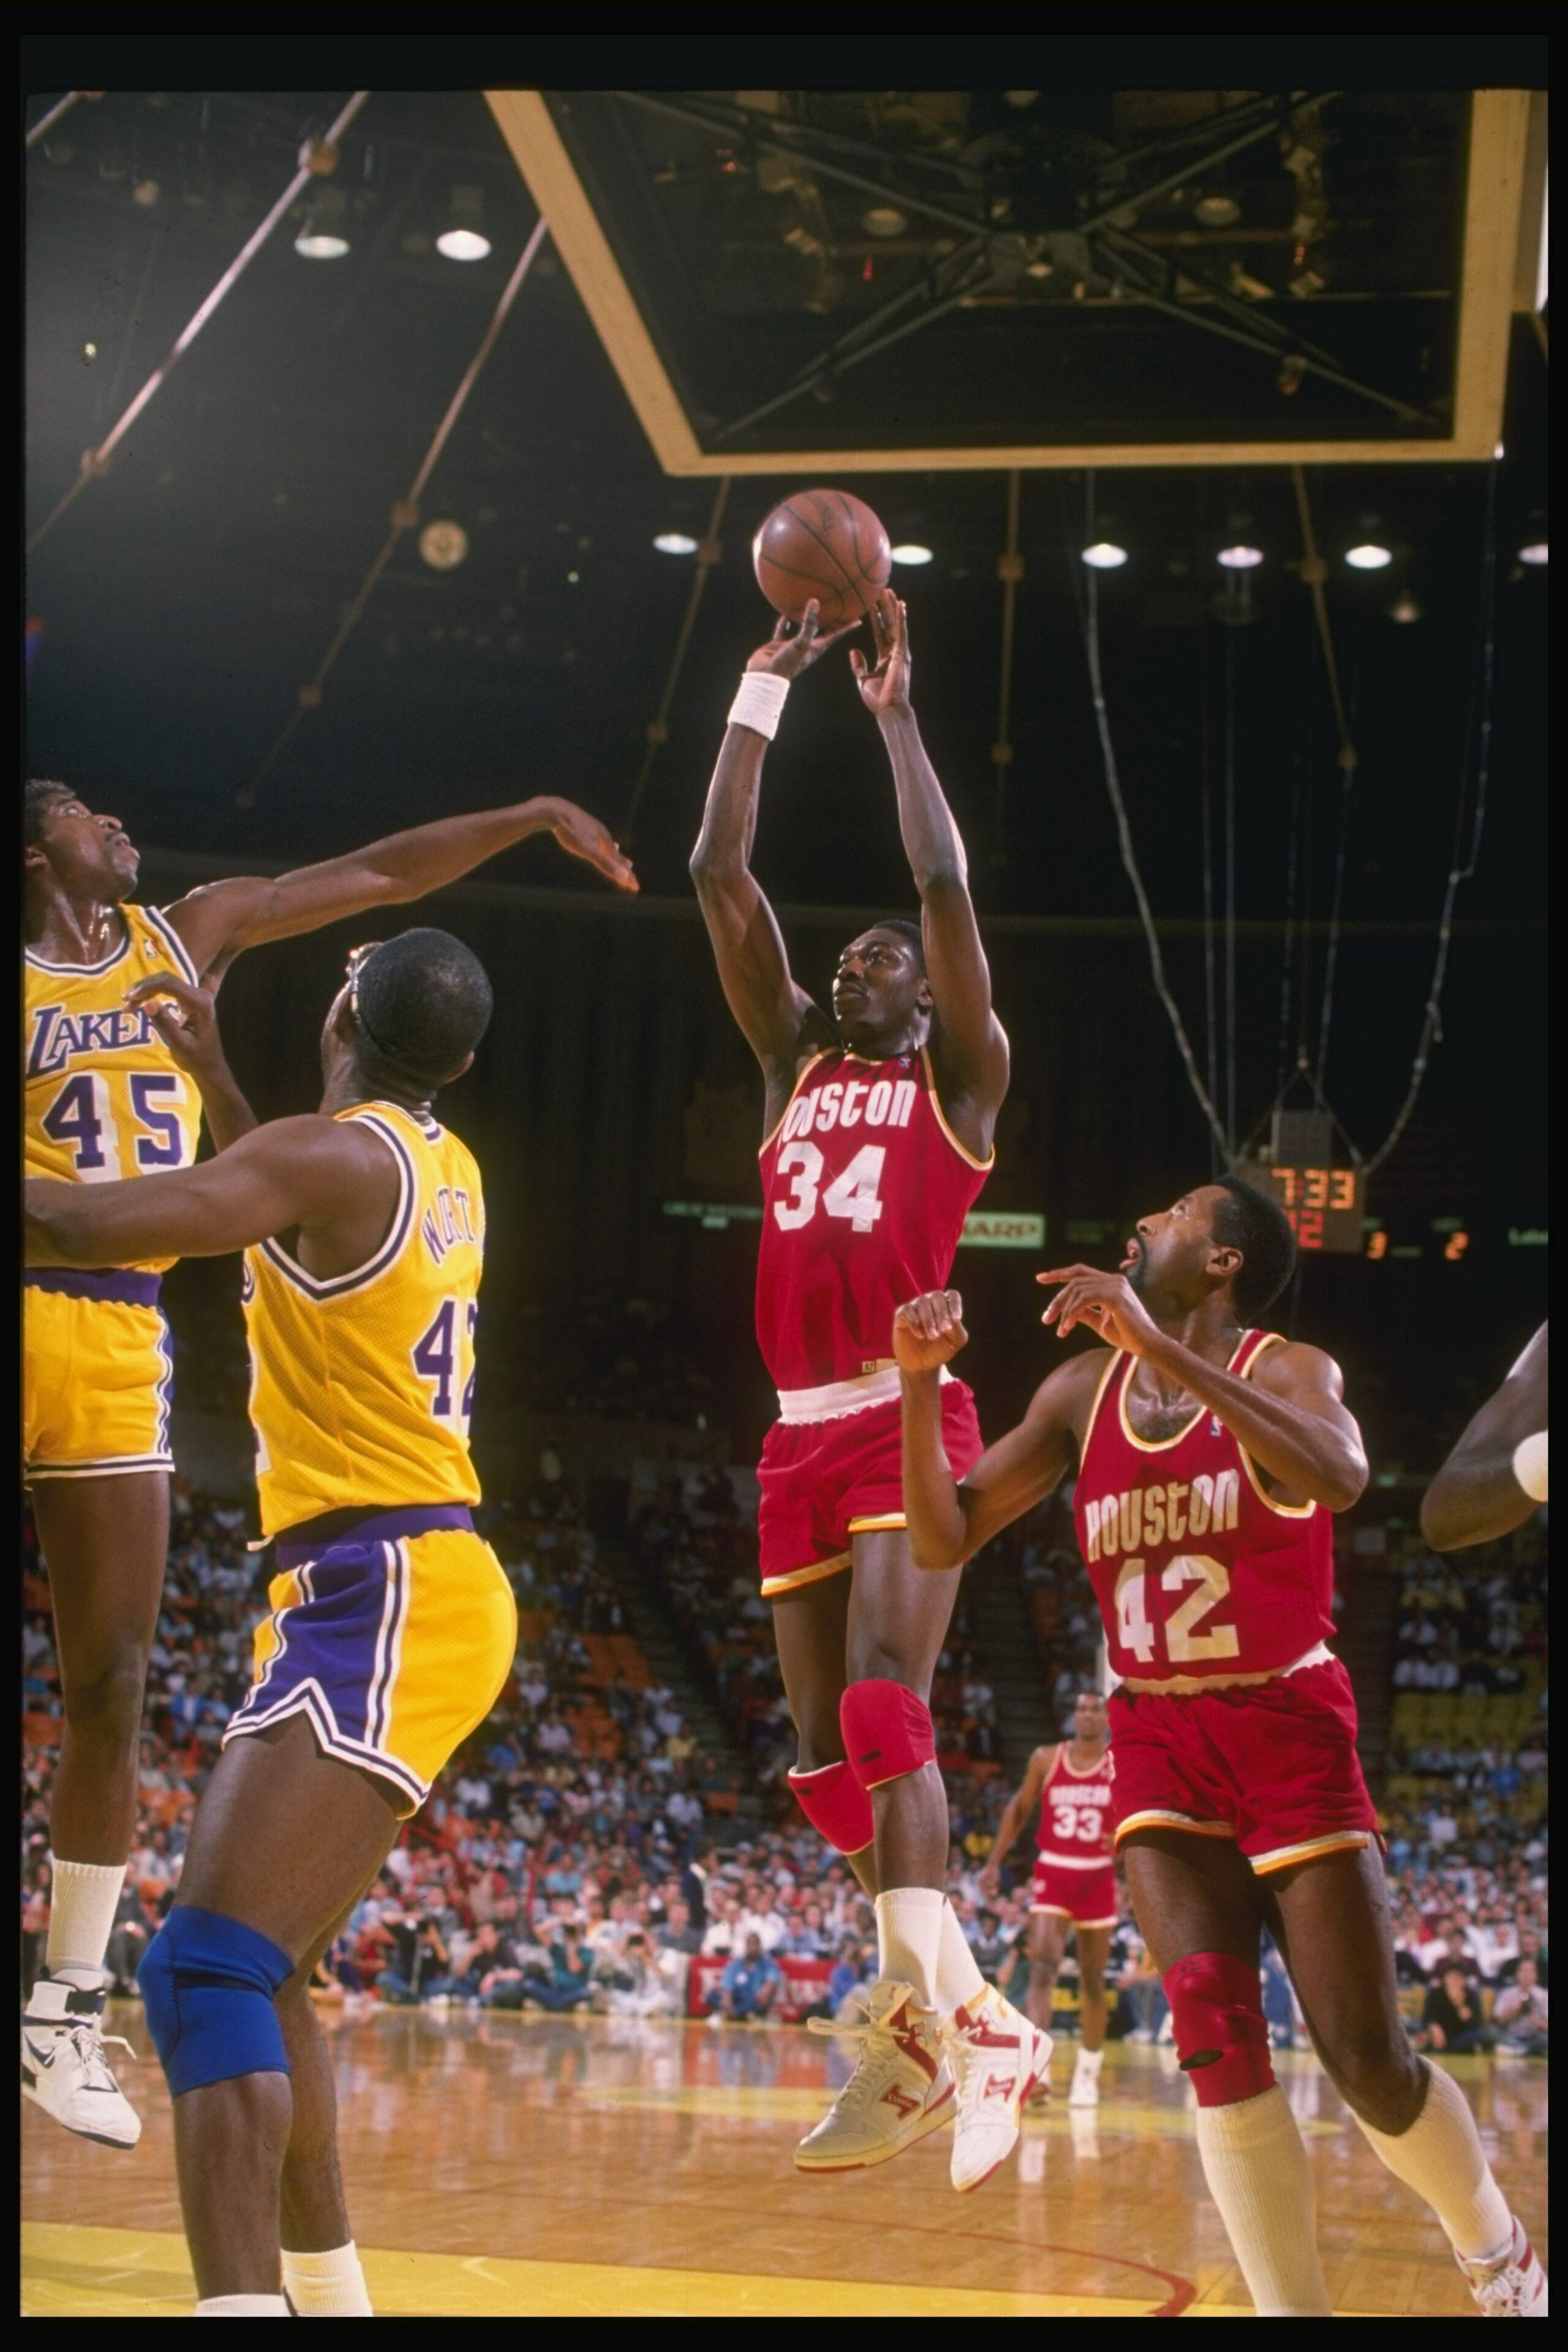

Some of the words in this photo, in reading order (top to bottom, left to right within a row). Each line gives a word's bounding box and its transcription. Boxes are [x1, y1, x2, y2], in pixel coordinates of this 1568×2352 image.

[40, 1072, 187, 1183] 45
[778, 1080, 918, 1144] OUSTON
[774, 1140, 886, 1233] 34
[1271, 1167, 1355, 1210] 7:33
[1114, 1554, 1240, 1663] 42
[1052, 1805, 1102, 1843] 33
